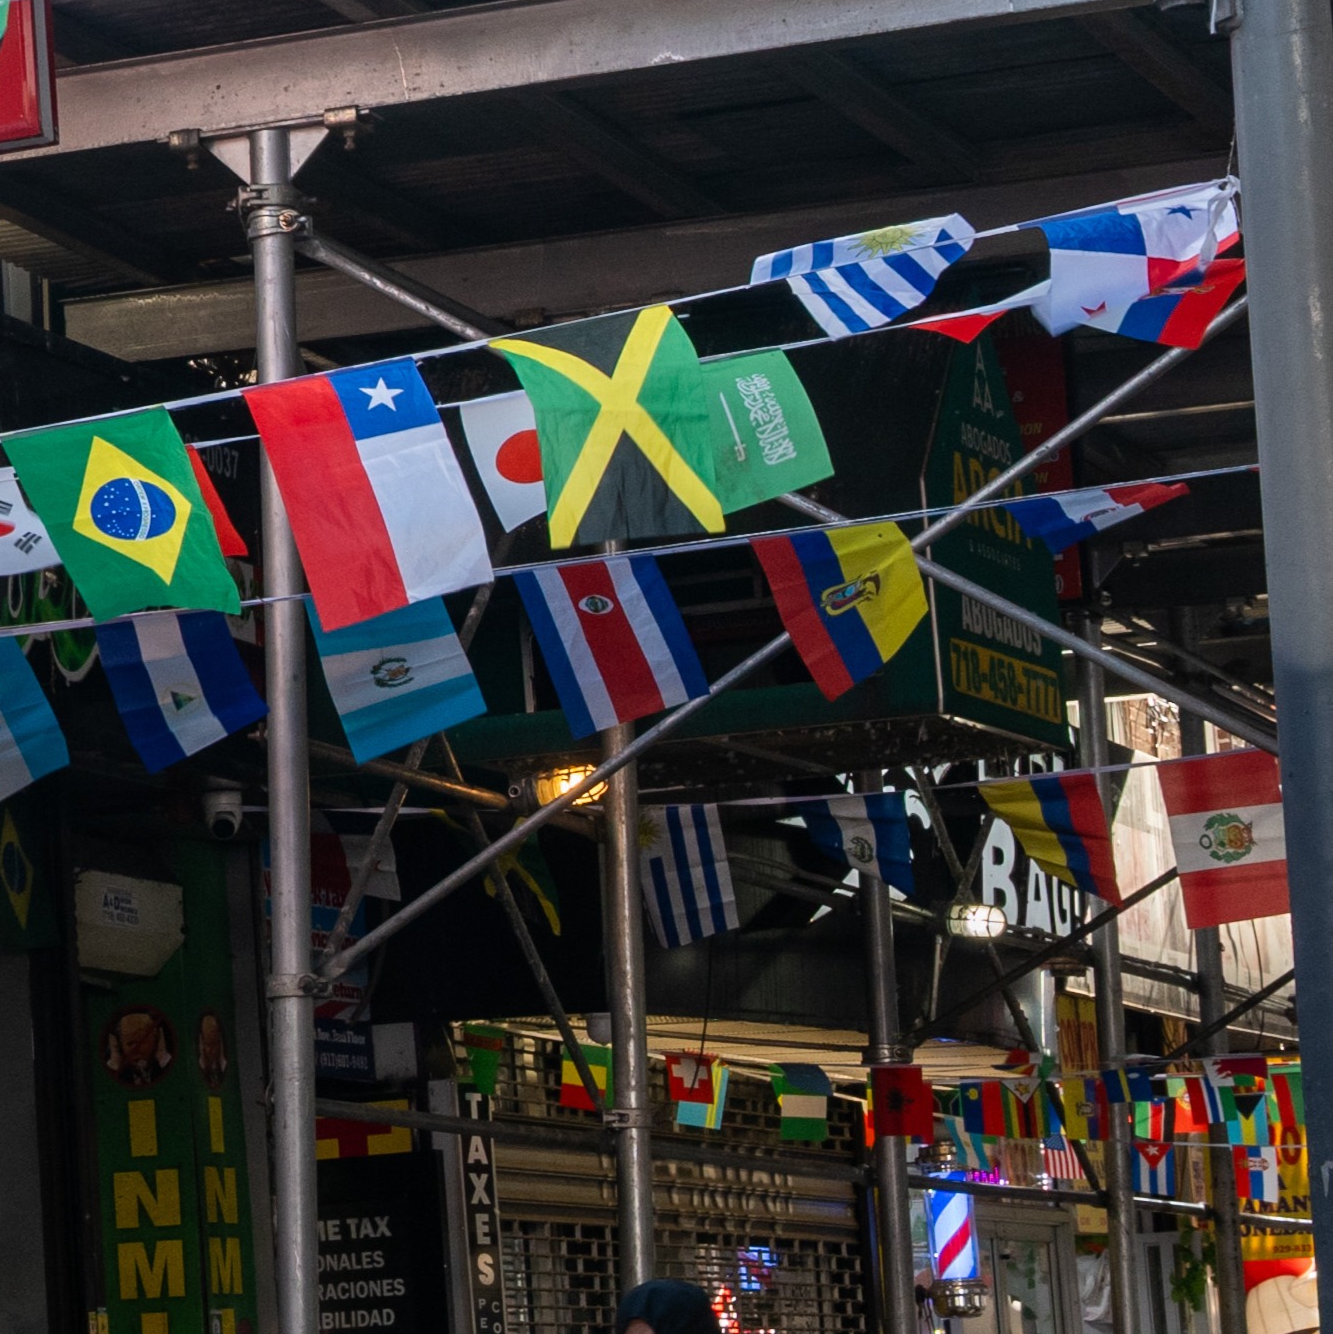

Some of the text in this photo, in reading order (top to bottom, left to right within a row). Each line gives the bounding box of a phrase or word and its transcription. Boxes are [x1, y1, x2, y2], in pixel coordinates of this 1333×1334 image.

[961, 594, 1043, 657] ABOGADOS
[464, 1092, 497, 1287] TAXES
[346, 1215, 393, 1240] TAX
